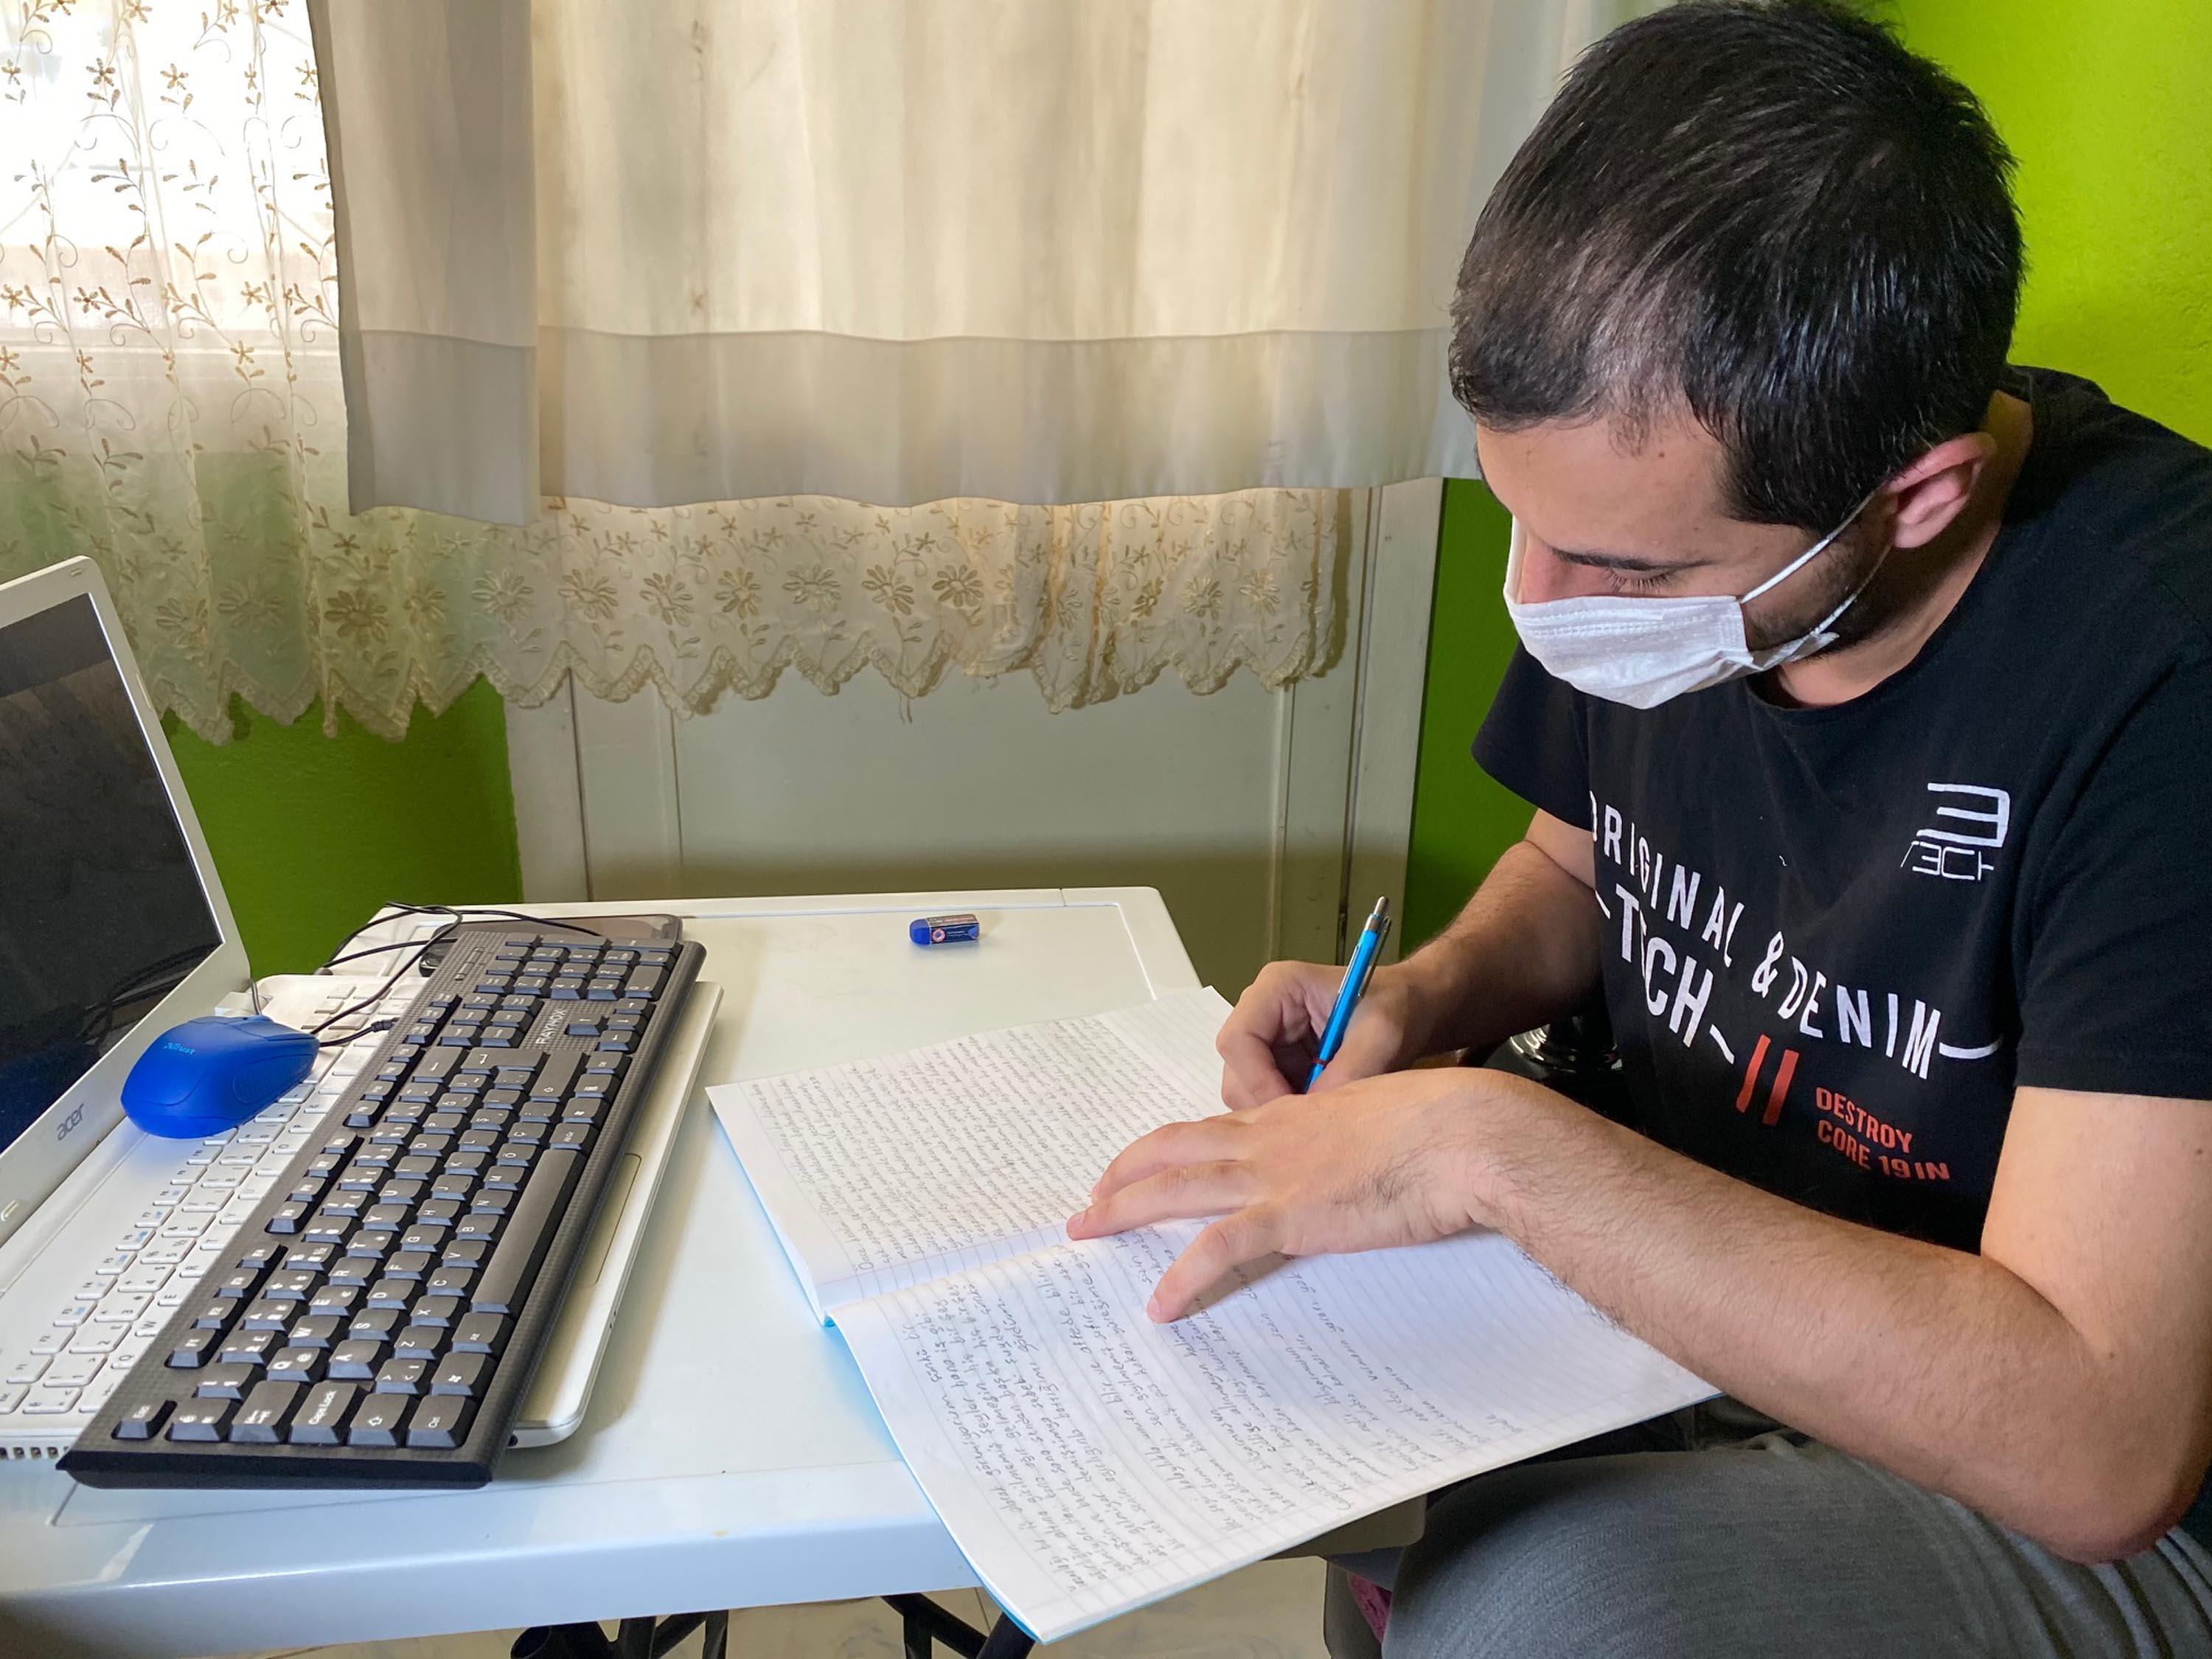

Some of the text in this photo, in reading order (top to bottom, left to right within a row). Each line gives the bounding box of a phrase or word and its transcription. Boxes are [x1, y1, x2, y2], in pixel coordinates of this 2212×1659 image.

[1751, 931, 1784, 998] &
[1778, 956, 1941, 1079] DENIM
[534, 1009, 566, 1044] RAYNOX
[172, 1043, 195, 1056] Trust
[56, 1103, 85, 1141] acer
[1816, 1087, 1913, 1153] DESTROY
[1818, 1119, 1871, 1171] CORE
[1879, 1155, 1912, 1178] 19
[844, 1247, 874, 1271] Önce
[901, 1322, 920, 1340] bir
[915, 1312, 945, 1335] gibi
[989, 1298, 1038, 1352] gördüm.
[942, 1358, 967, 1388] bana
[1089, 1360, 1105, 1375] ve
[1144, 1406, 1163, 1426] sen
